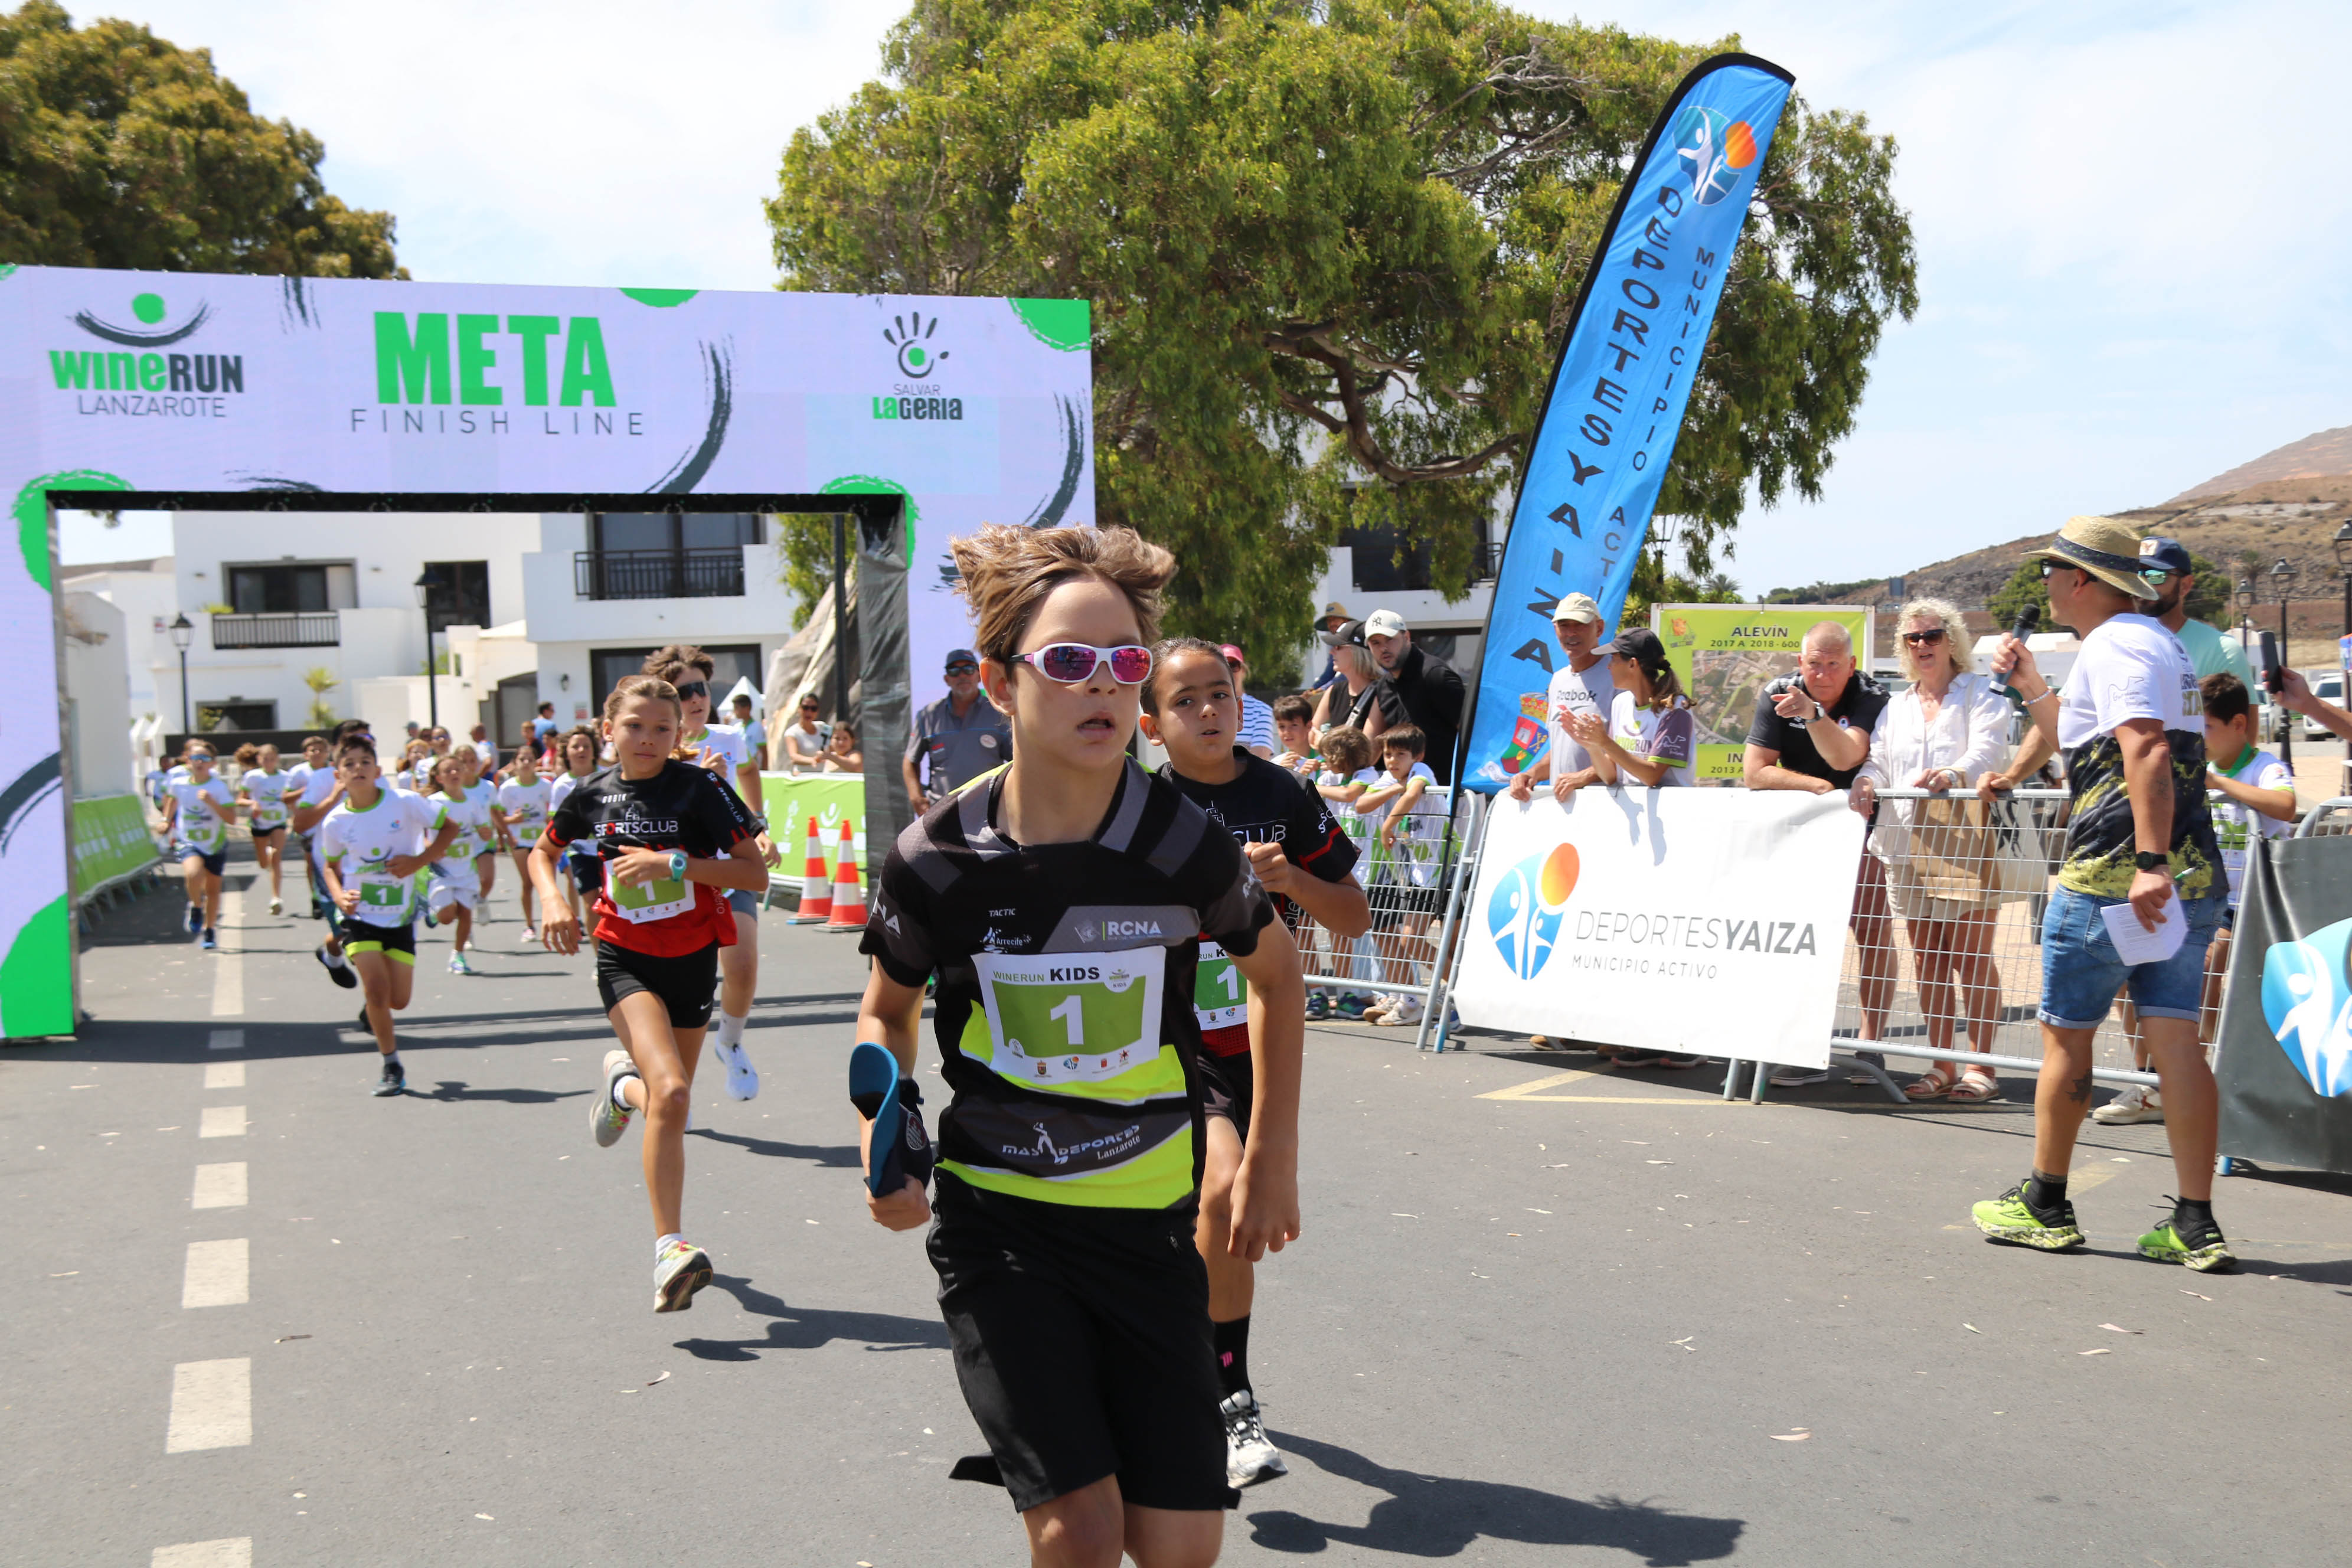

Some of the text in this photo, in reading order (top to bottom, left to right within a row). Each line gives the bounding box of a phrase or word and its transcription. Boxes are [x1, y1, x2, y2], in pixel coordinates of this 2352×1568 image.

[373, 311, 618, 407] META
[1632, 247, 1713, 472] MUNICIPIO
[893, 383, 941, 396] SALVAR
[78, 394, 227, 417] LANZAROTE
[351, 409, 644, 436] FINISH LINE
[594, 820, 679, 837] SPORTSCLUB
[375, 887, 388, 904] 1
[637, 879, 656, 901] 1
[988, 908, 1016, 917] TACTIC
[1108, 920, 1162, 936] RCNA
[1576, 910, 1817, 956] DEPORTESYAIZA
[997, 937, 1023, 946] Arrecife
[992, 970, 1045, 982] WINERUN
[1050, 966, 1100, 982] KIDS
[1572, 954, 1718, 979] MUNICIPIO ACTIVO
[1216, 964, 1239, 1001] 1
[1050, 995, 1084, 1046] 1
[1096, 1134, 1141, 1160] Lanzarote
